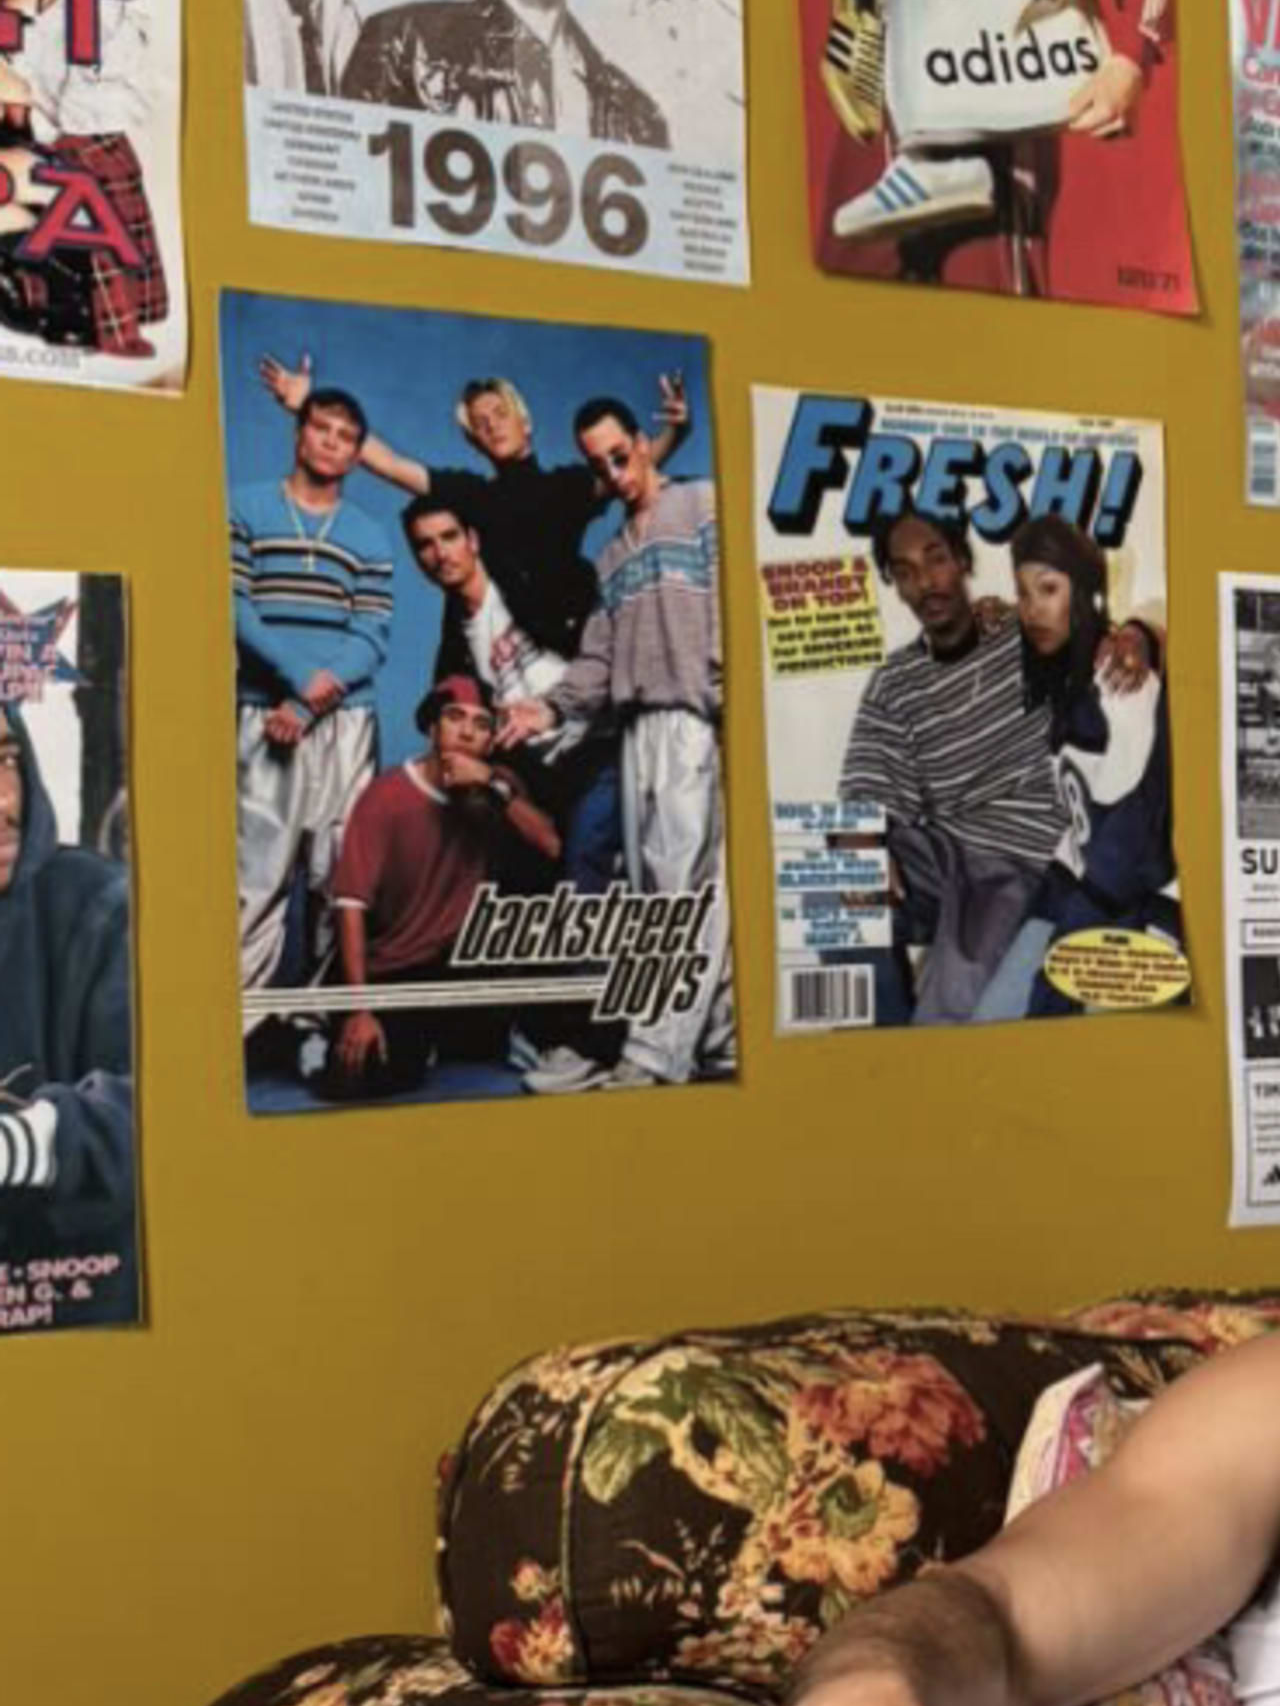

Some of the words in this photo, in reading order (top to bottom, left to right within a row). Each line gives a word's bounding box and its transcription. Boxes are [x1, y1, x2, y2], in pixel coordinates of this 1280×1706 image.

[926, 29, 1100, 89] adidas
[367, 116, 650, 258] 1996
[767, 393, 1142, 549] FRESH!
[452, 881, 720, 968] backstreet
[592, 945, 711, 1028] boys
[27, 1253, 121, 1282] SNOOP
